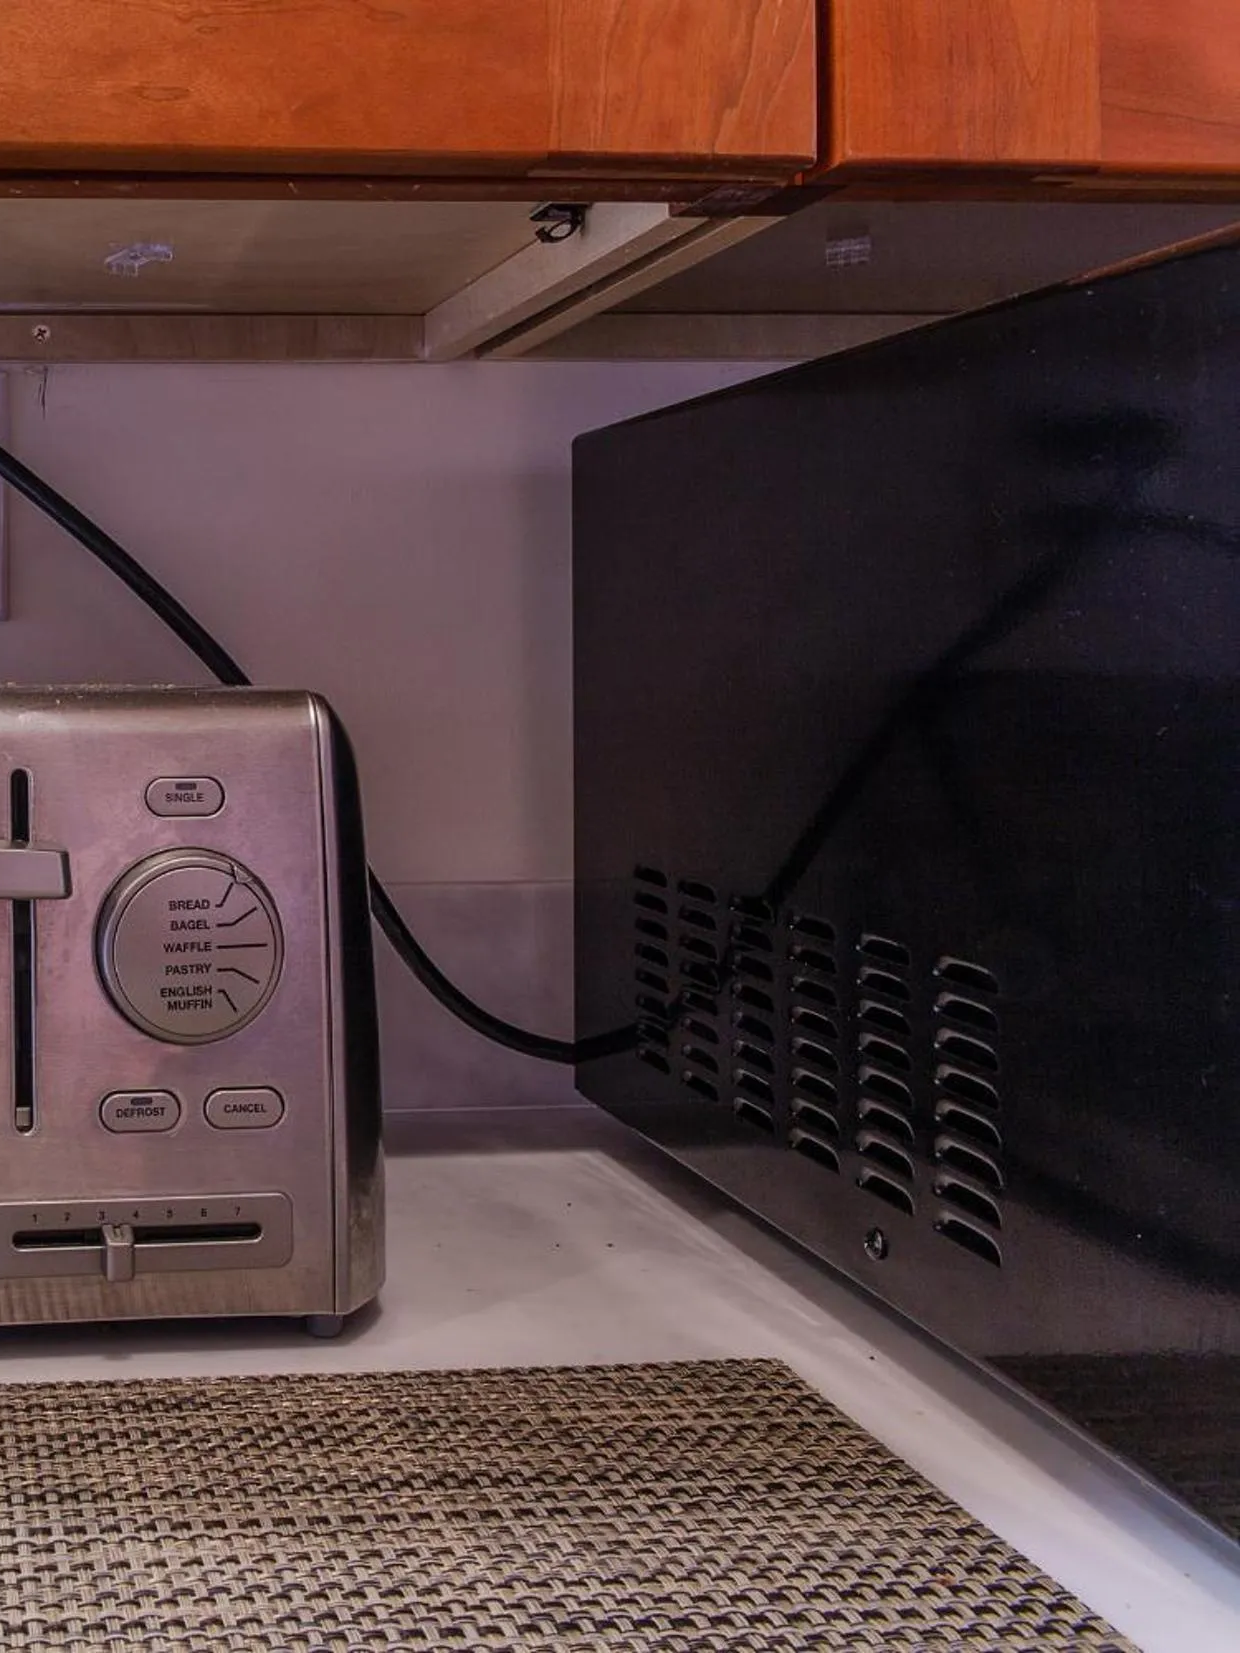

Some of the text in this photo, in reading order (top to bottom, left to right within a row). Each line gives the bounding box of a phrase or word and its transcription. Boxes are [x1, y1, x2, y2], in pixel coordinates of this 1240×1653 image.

[164, 792, 205, 803] SINGLE
[168, 899, 210, 911] BREAD
[170, 919, 210, 931] BAGEL
[163, 942, 213, 953] WAFFLE
[164, 963, 212, 975] PASTRY
[160, 986, 213, 998] ENGLISH
[166, 999, 213, 1011] MUFFIN
[115, 1106, 167, 1118] DEFROST
[223, 1103, 267, 1114] CANCEL
